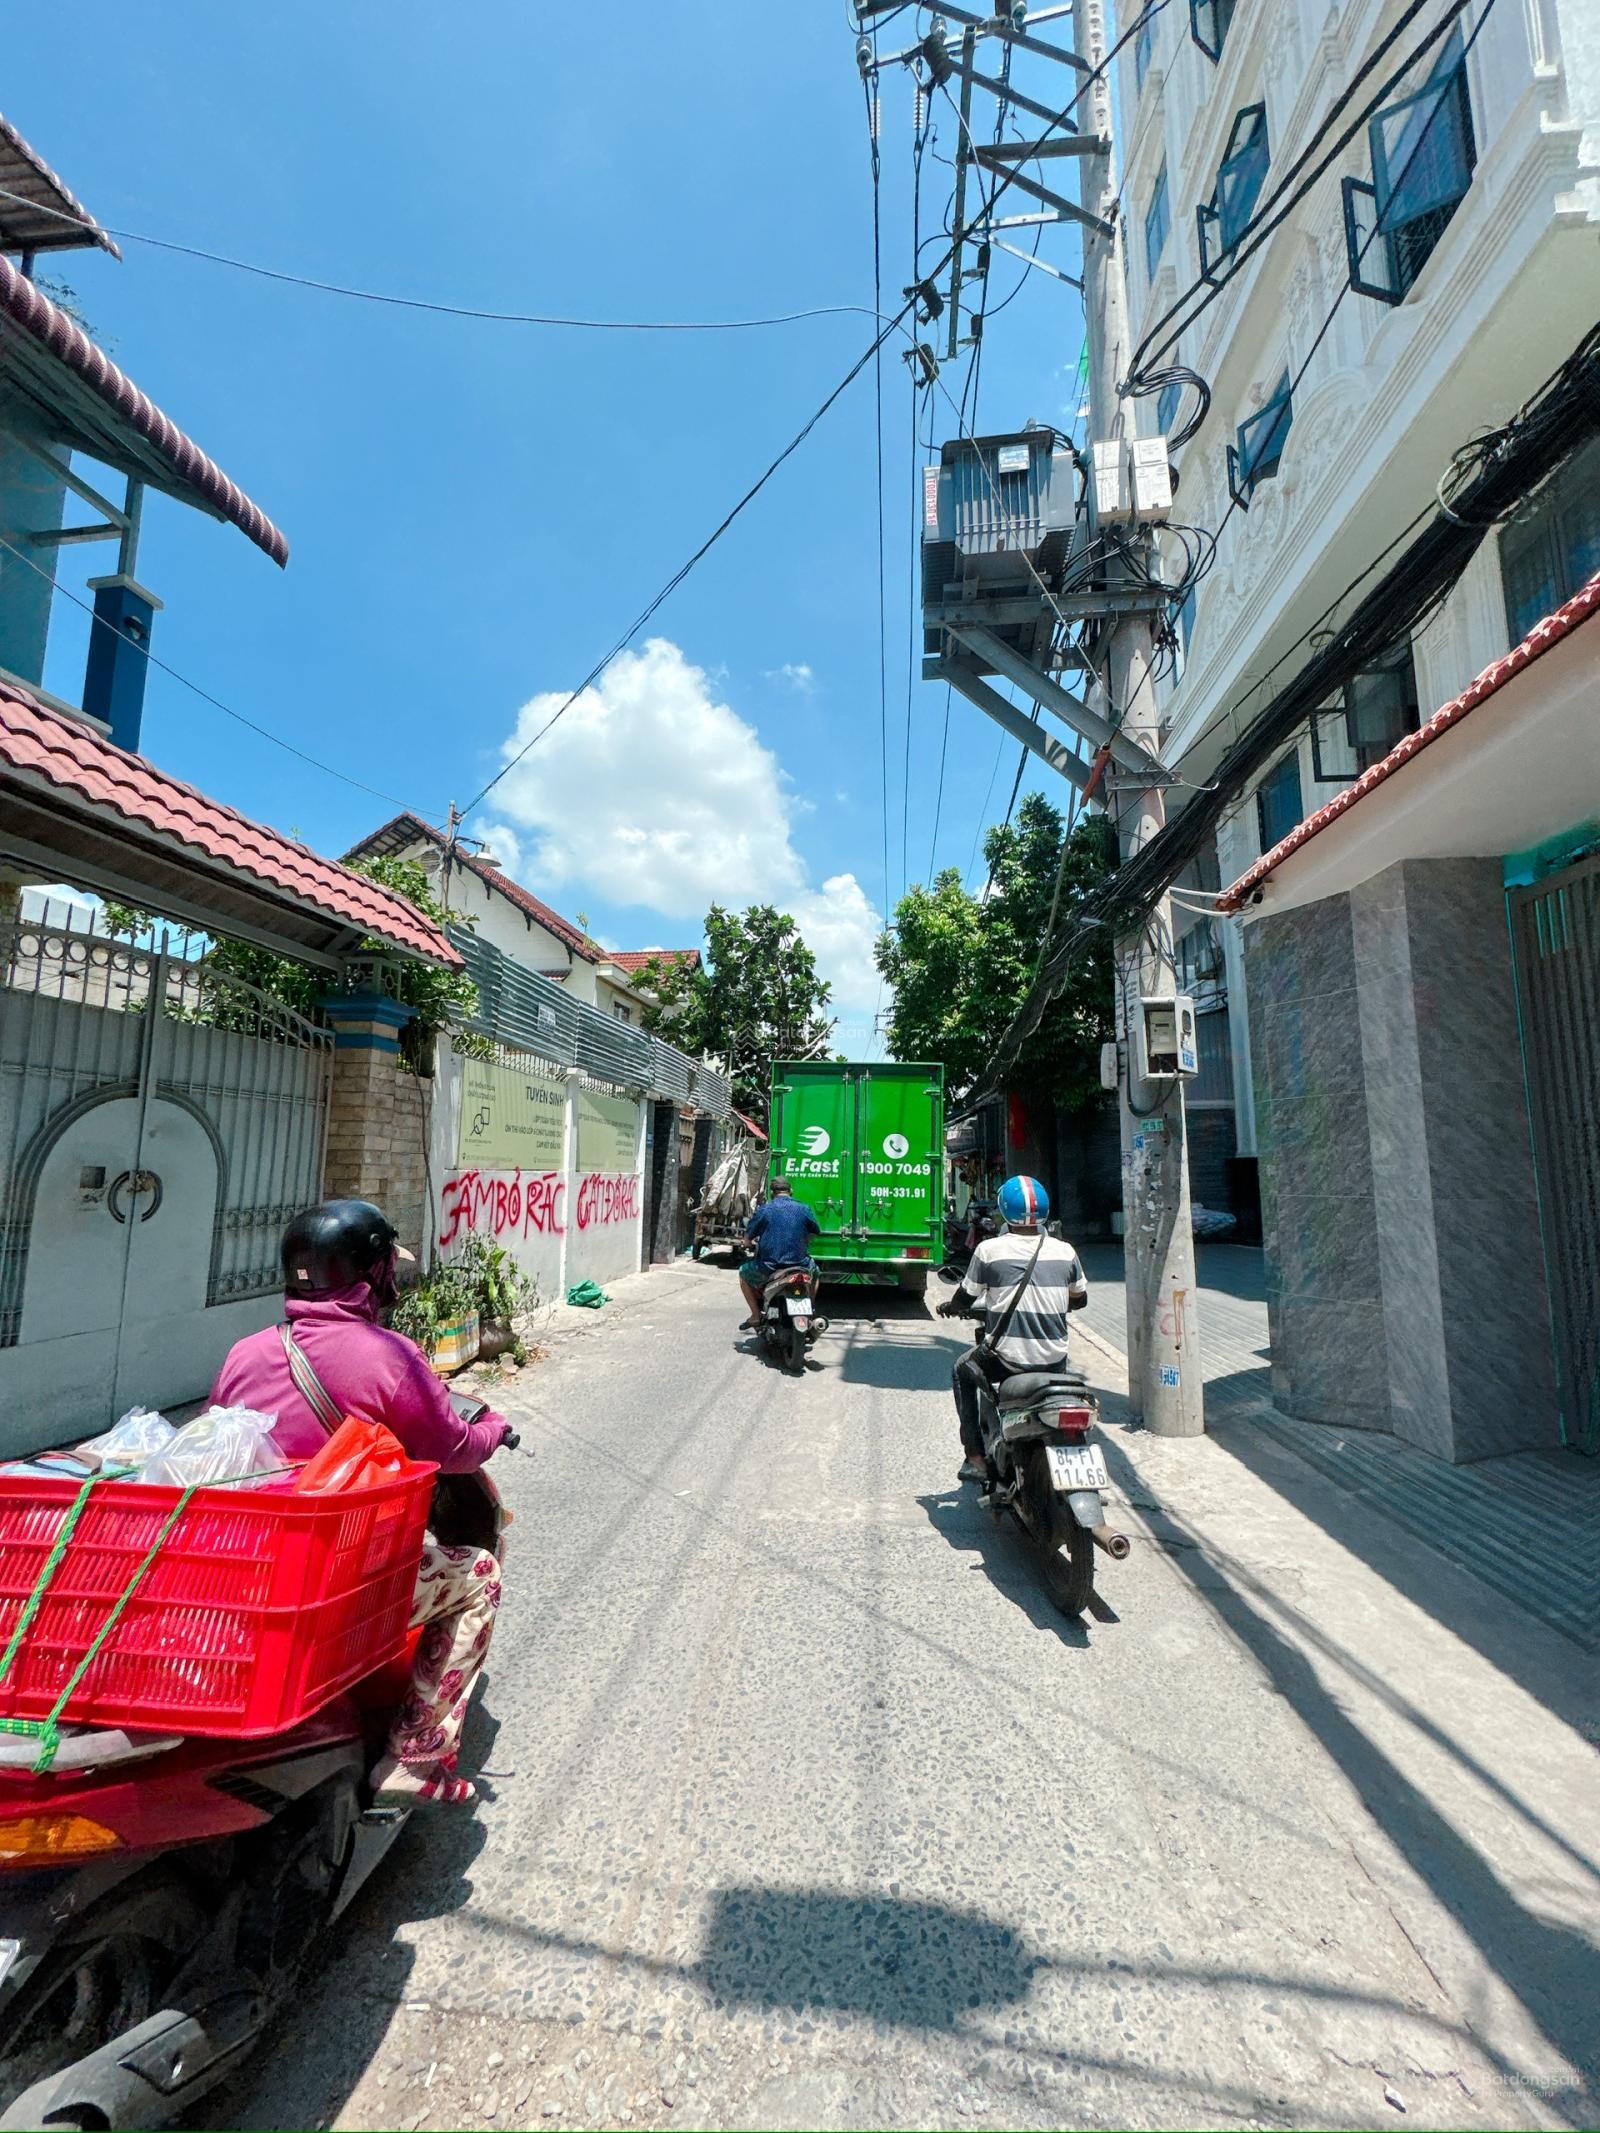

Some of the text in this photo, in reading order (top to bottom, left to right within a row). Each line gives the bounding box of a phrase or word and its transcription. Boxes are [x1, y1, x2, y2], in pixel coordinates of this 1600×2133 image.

[785, 1157, 840, 1173] E.Fast
[859, 1162, 931, 1176] 1900 7049
[870, 1186, 926, 1199] 50H-331.91
[1054, 1468, 1106, 1487] 114.66
